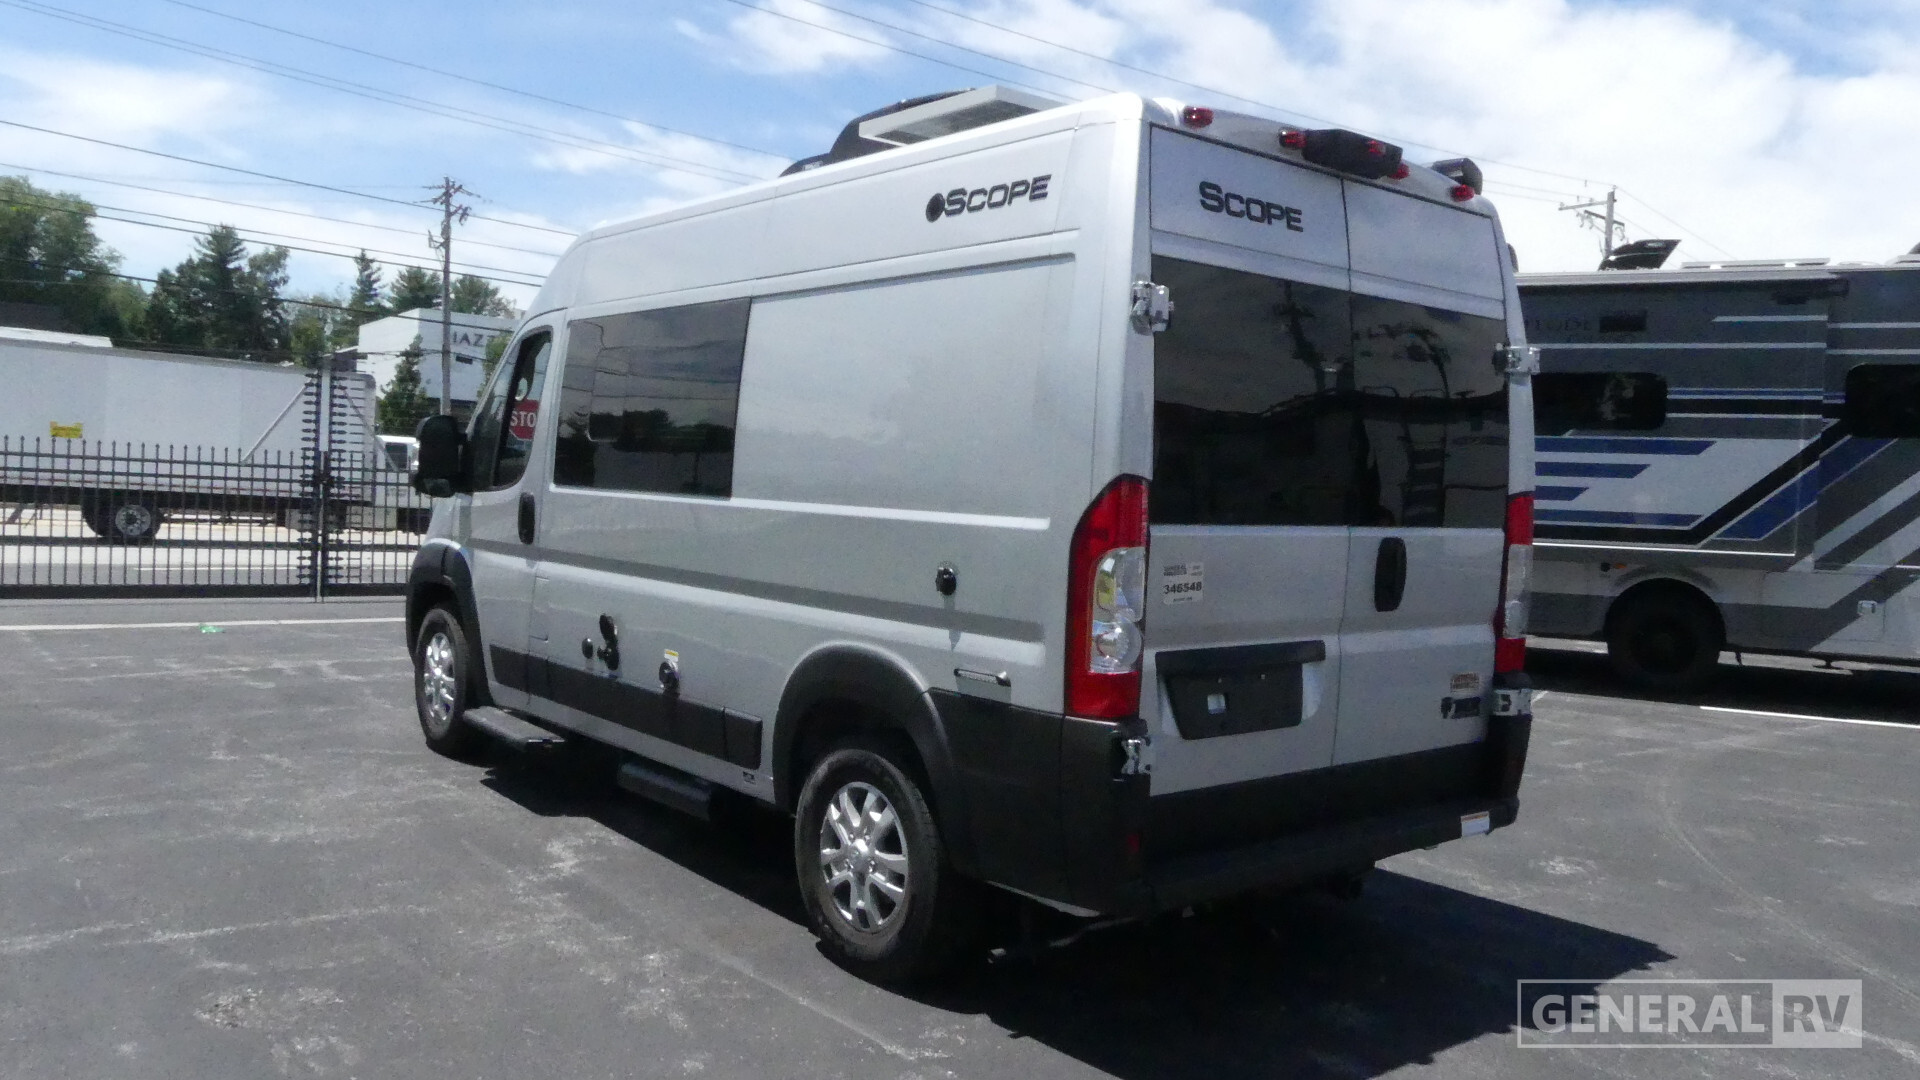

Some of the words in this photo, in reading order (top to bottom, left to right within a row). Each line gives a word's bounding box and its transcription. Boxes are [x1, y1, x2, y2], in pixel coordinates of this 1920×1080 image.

[944, 174, 1052, 217] SCOPE
[1199, 181, 1304, 232] SCOPE
[510, 410, 536, 427] STO
[1163, 581, 1202, 594] 346548
